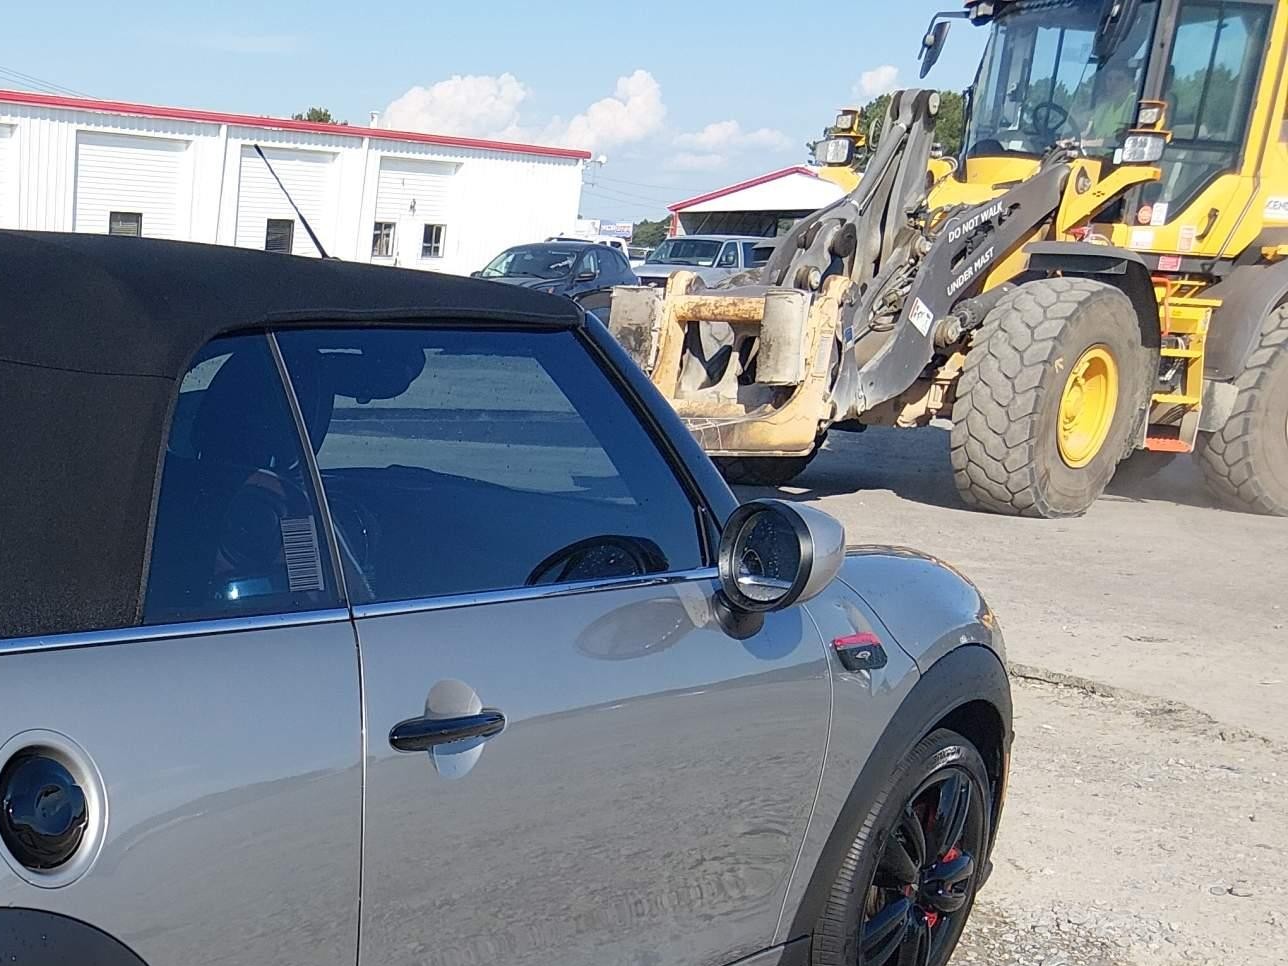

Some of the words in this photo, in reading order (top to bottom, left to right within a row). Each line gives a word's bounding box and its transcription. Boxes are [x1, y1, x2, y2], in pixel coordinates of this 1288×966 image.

[948, 226, 961, 243] DO
[962, 214, 980, 234] NOT
[980, 201, 1004, 222] WALK
[946, 266, 974, 296] UNDER
[973, 246, 994, 272] MAST
